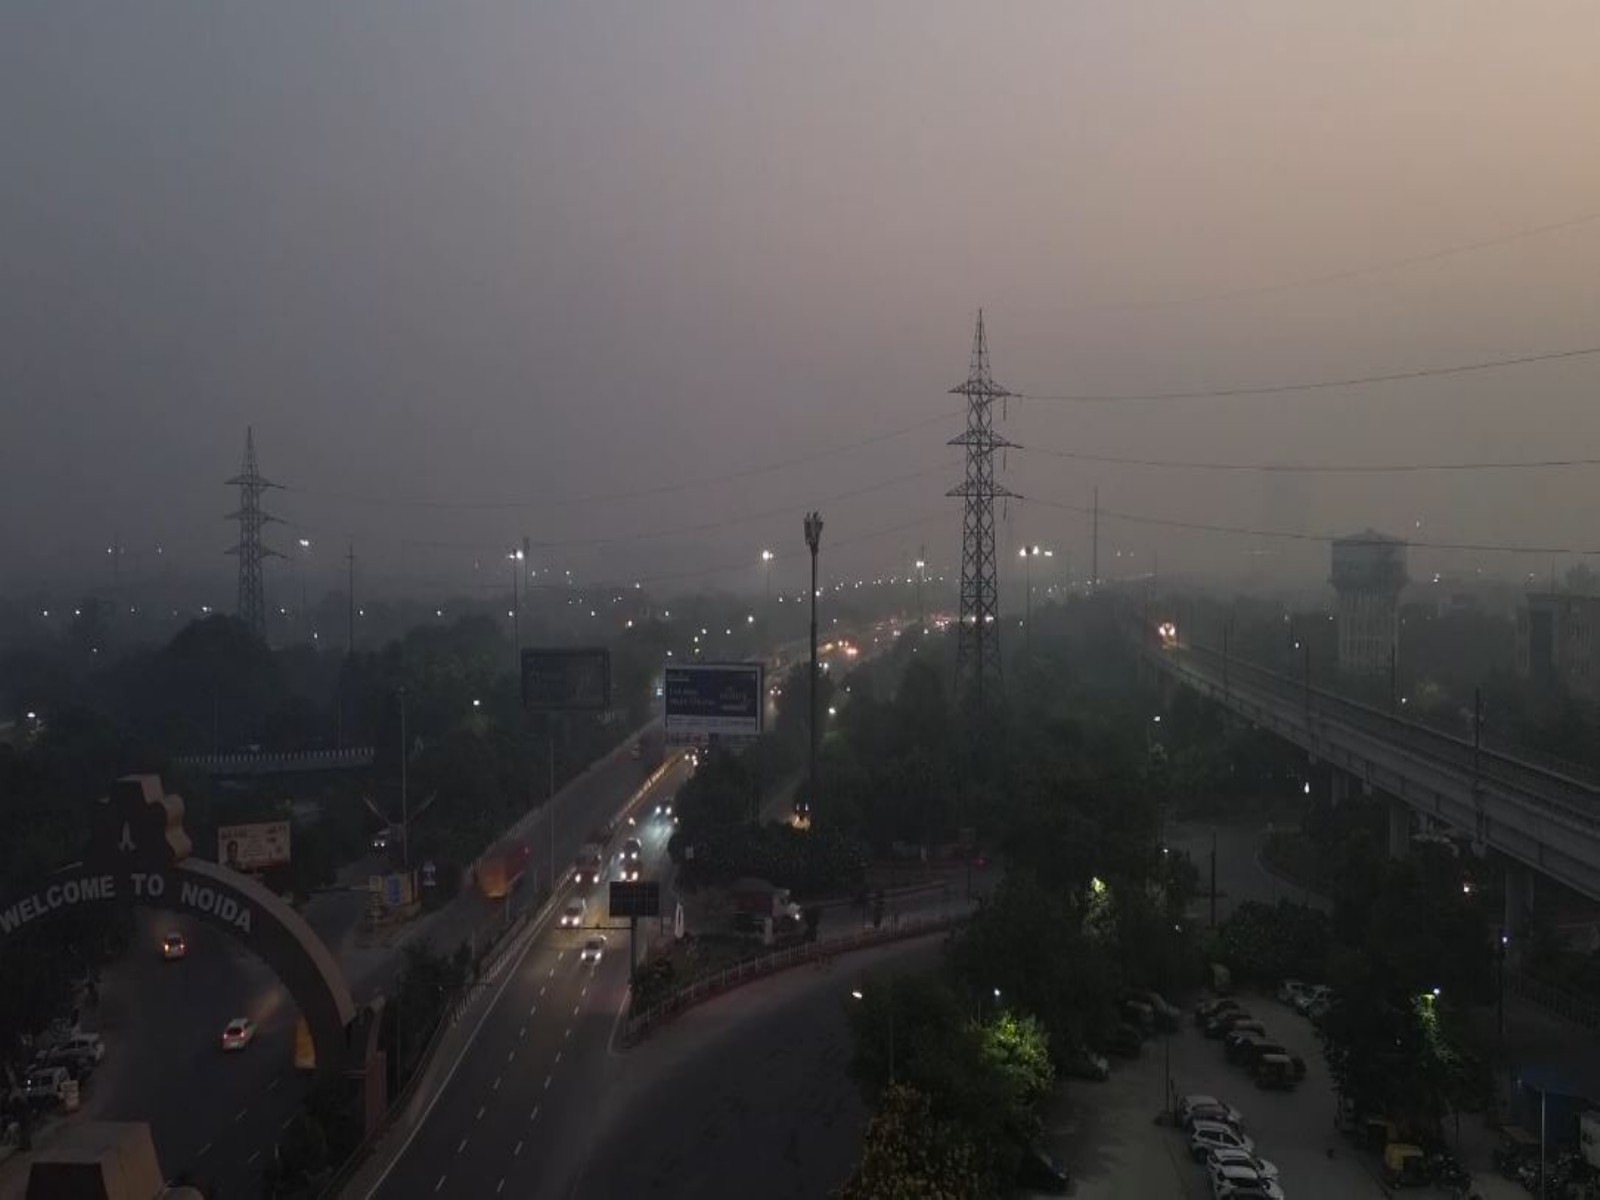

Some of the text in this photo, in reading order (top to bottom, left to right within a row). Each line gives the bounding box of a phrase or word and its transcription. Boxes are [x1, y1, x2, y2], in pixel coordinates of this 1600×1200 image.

[0, 873, 252, 934] WELCOME TO NOIDA
